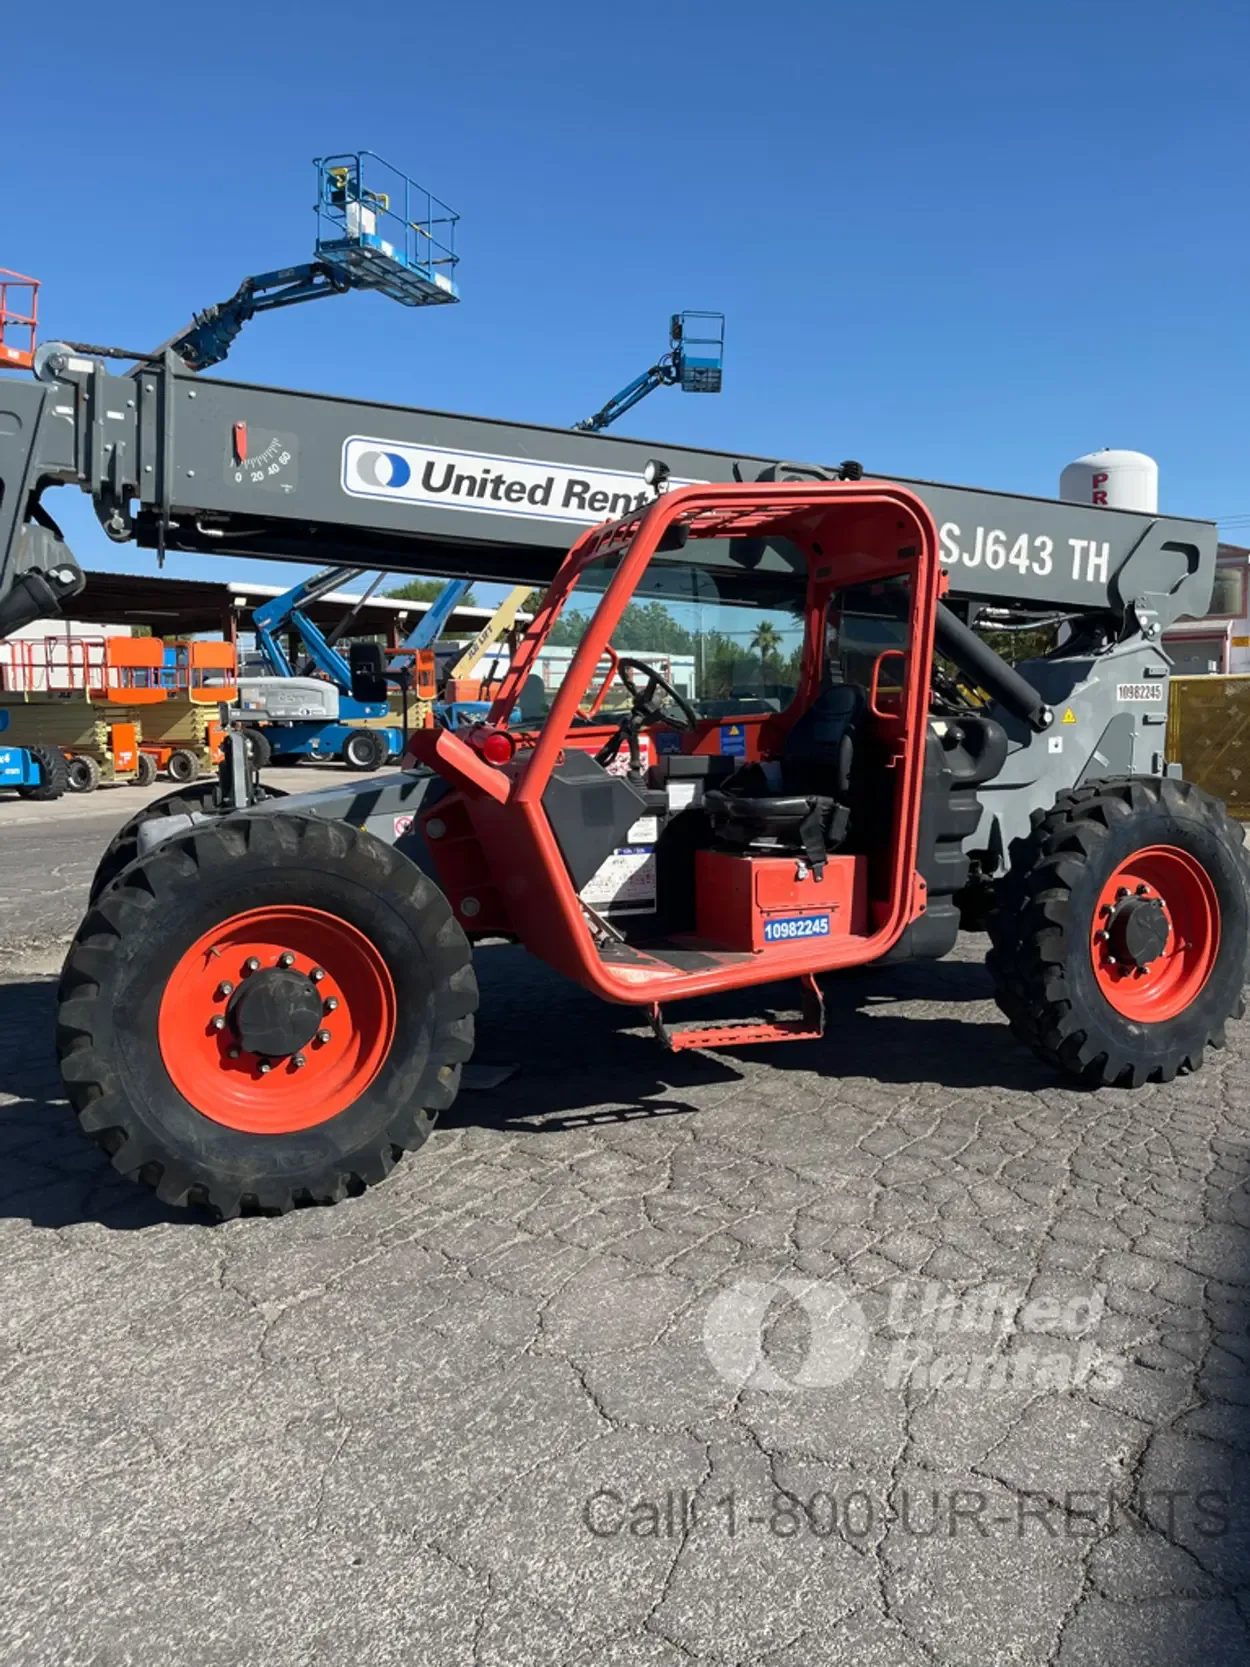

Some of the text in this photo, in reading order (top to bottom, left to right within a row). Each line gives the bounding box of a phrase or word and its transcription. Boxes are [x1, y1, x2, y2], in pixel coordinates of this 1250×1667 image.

[235, 451, 291, 483] 0 20 40 60
[421, 461, 554, 507] United
[939, 522, 1110, 583] SJ643 TH
[1119, 685, 1161, 699] 10982245
[765, 918, 829, 939] 10982245
